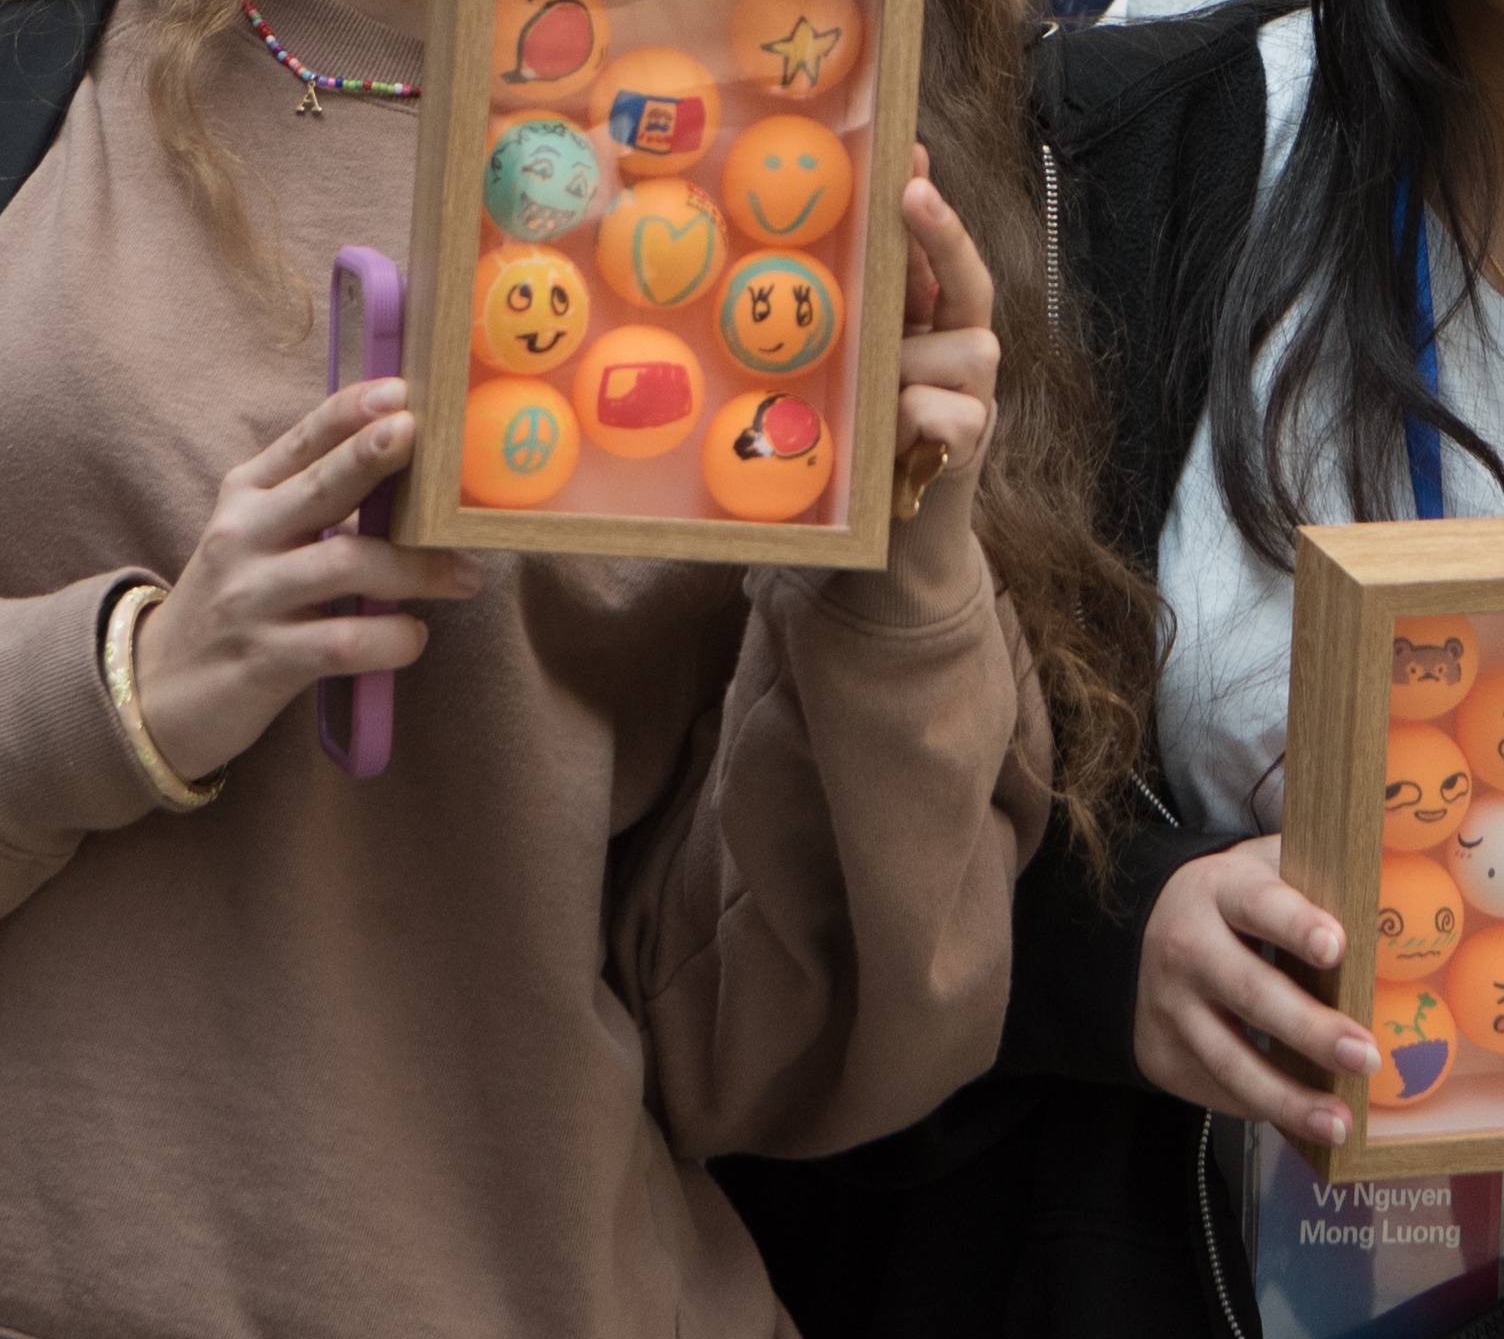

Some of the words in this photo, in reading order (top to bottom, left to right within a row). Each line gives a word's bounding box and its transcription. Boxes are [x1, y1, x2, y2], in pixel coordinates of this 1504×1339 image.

[1313, 1182, 1348, 1212] Vy
[1353, 1182, 1452, 1211] Nguyen
[1300, 1219, 1376, 1249] Mong
[1381, 1220, 1462, 1249] Luong
